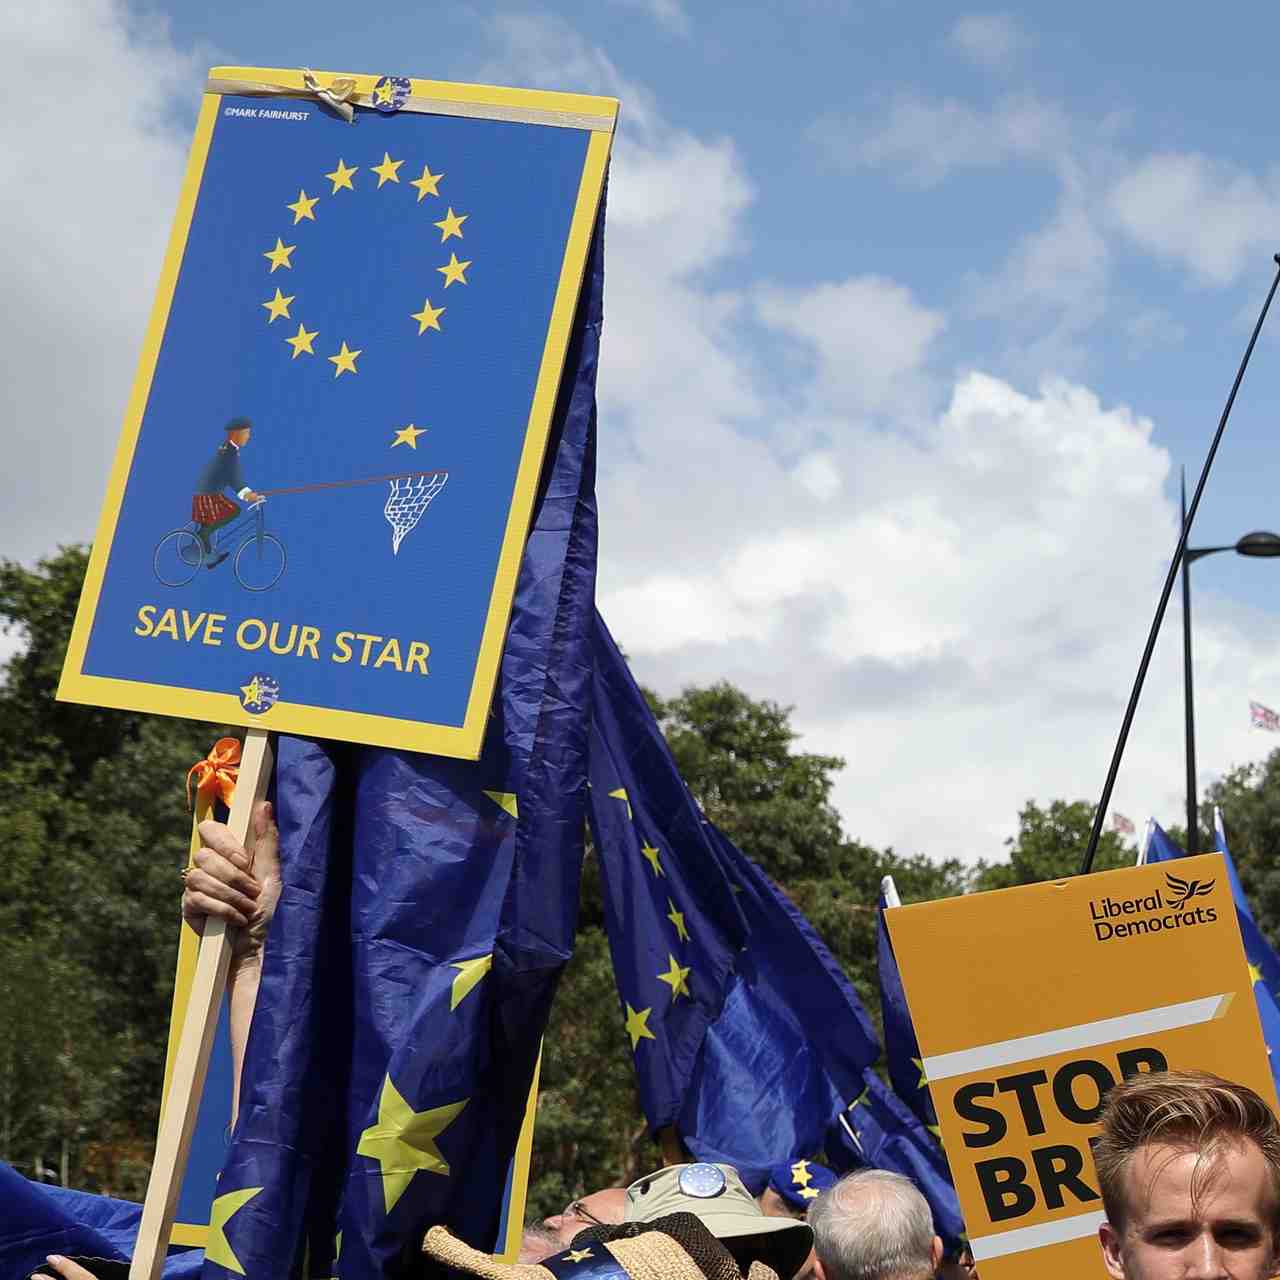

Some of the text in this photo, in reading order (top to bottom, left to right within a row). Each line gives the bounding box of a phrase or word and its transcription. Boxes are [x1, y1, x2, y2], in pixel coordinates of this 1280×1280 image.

[259, 109, 309, 121] FAIRHURST
[135, 604, 432, 675] SAVE OUR STAR
[1089, 889, 1163, 921] Liberal
[1094, 907, 1217, 942] Democrats
